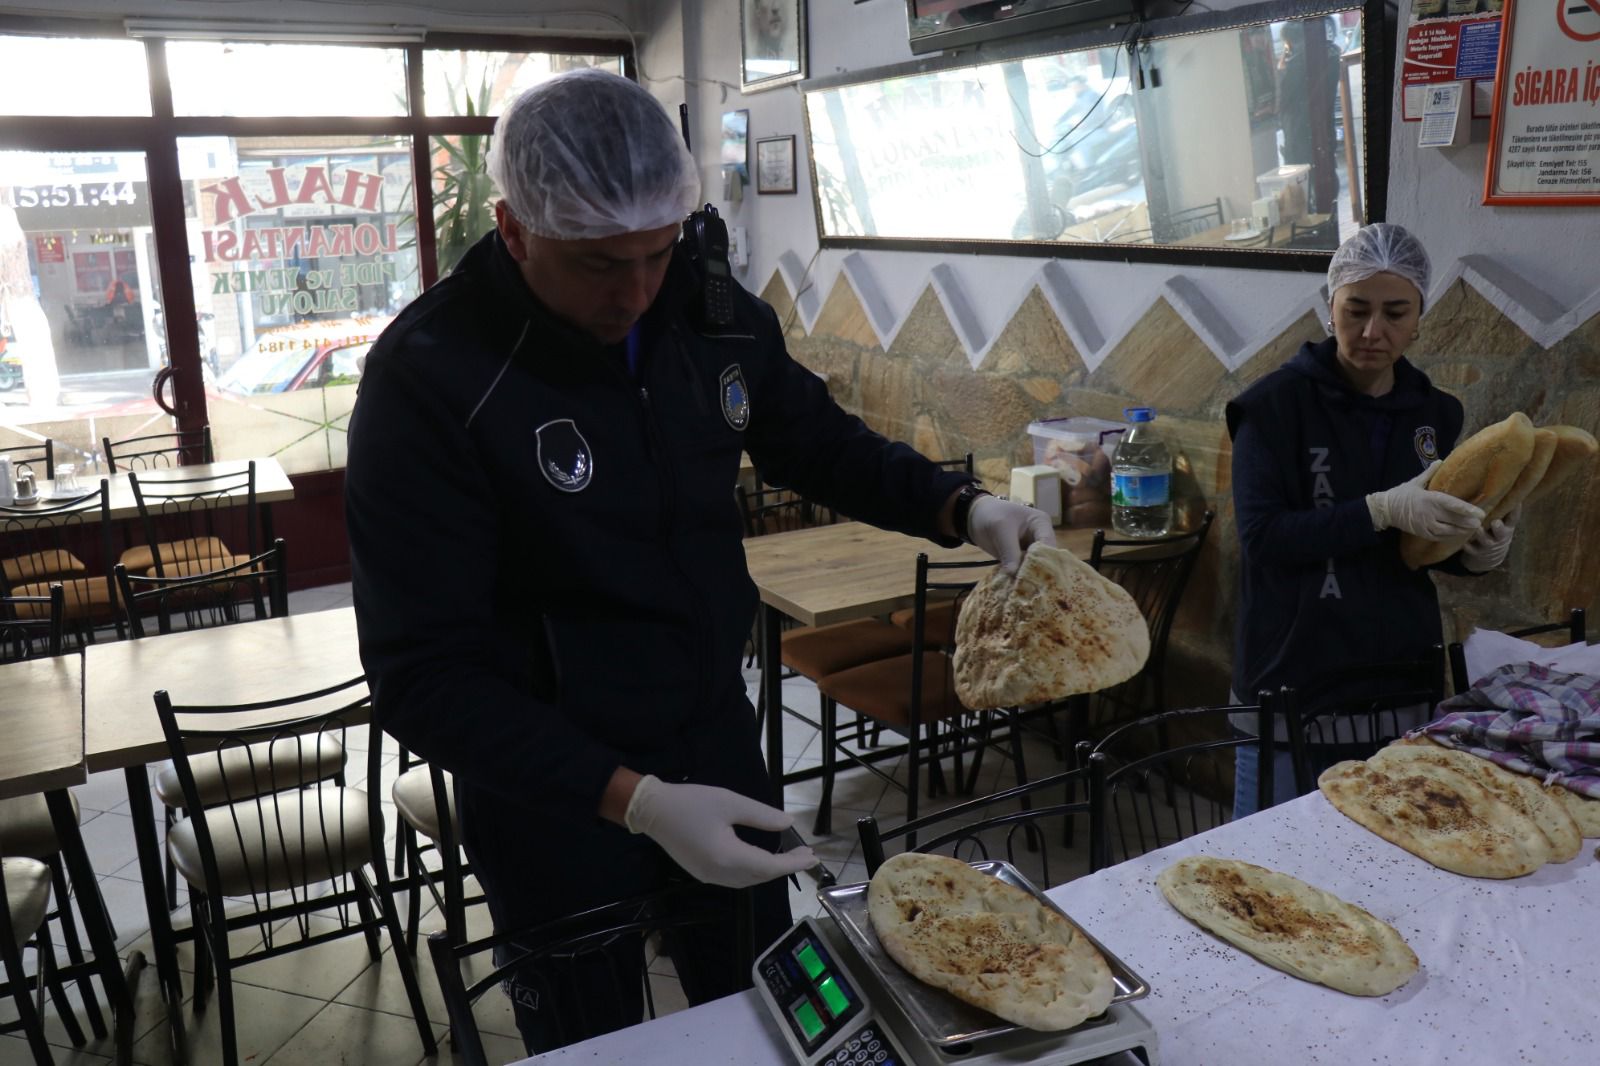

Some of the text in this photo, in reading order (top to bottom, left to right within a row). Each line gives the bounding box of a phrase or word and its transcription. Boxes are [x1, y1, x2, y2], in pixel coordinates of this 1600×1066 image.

[1513, 66, 1578, 106] SİGARA
[1540, 160, 1564, 168] Emniyet
[1308, 447, 1342, 599] ZAA
